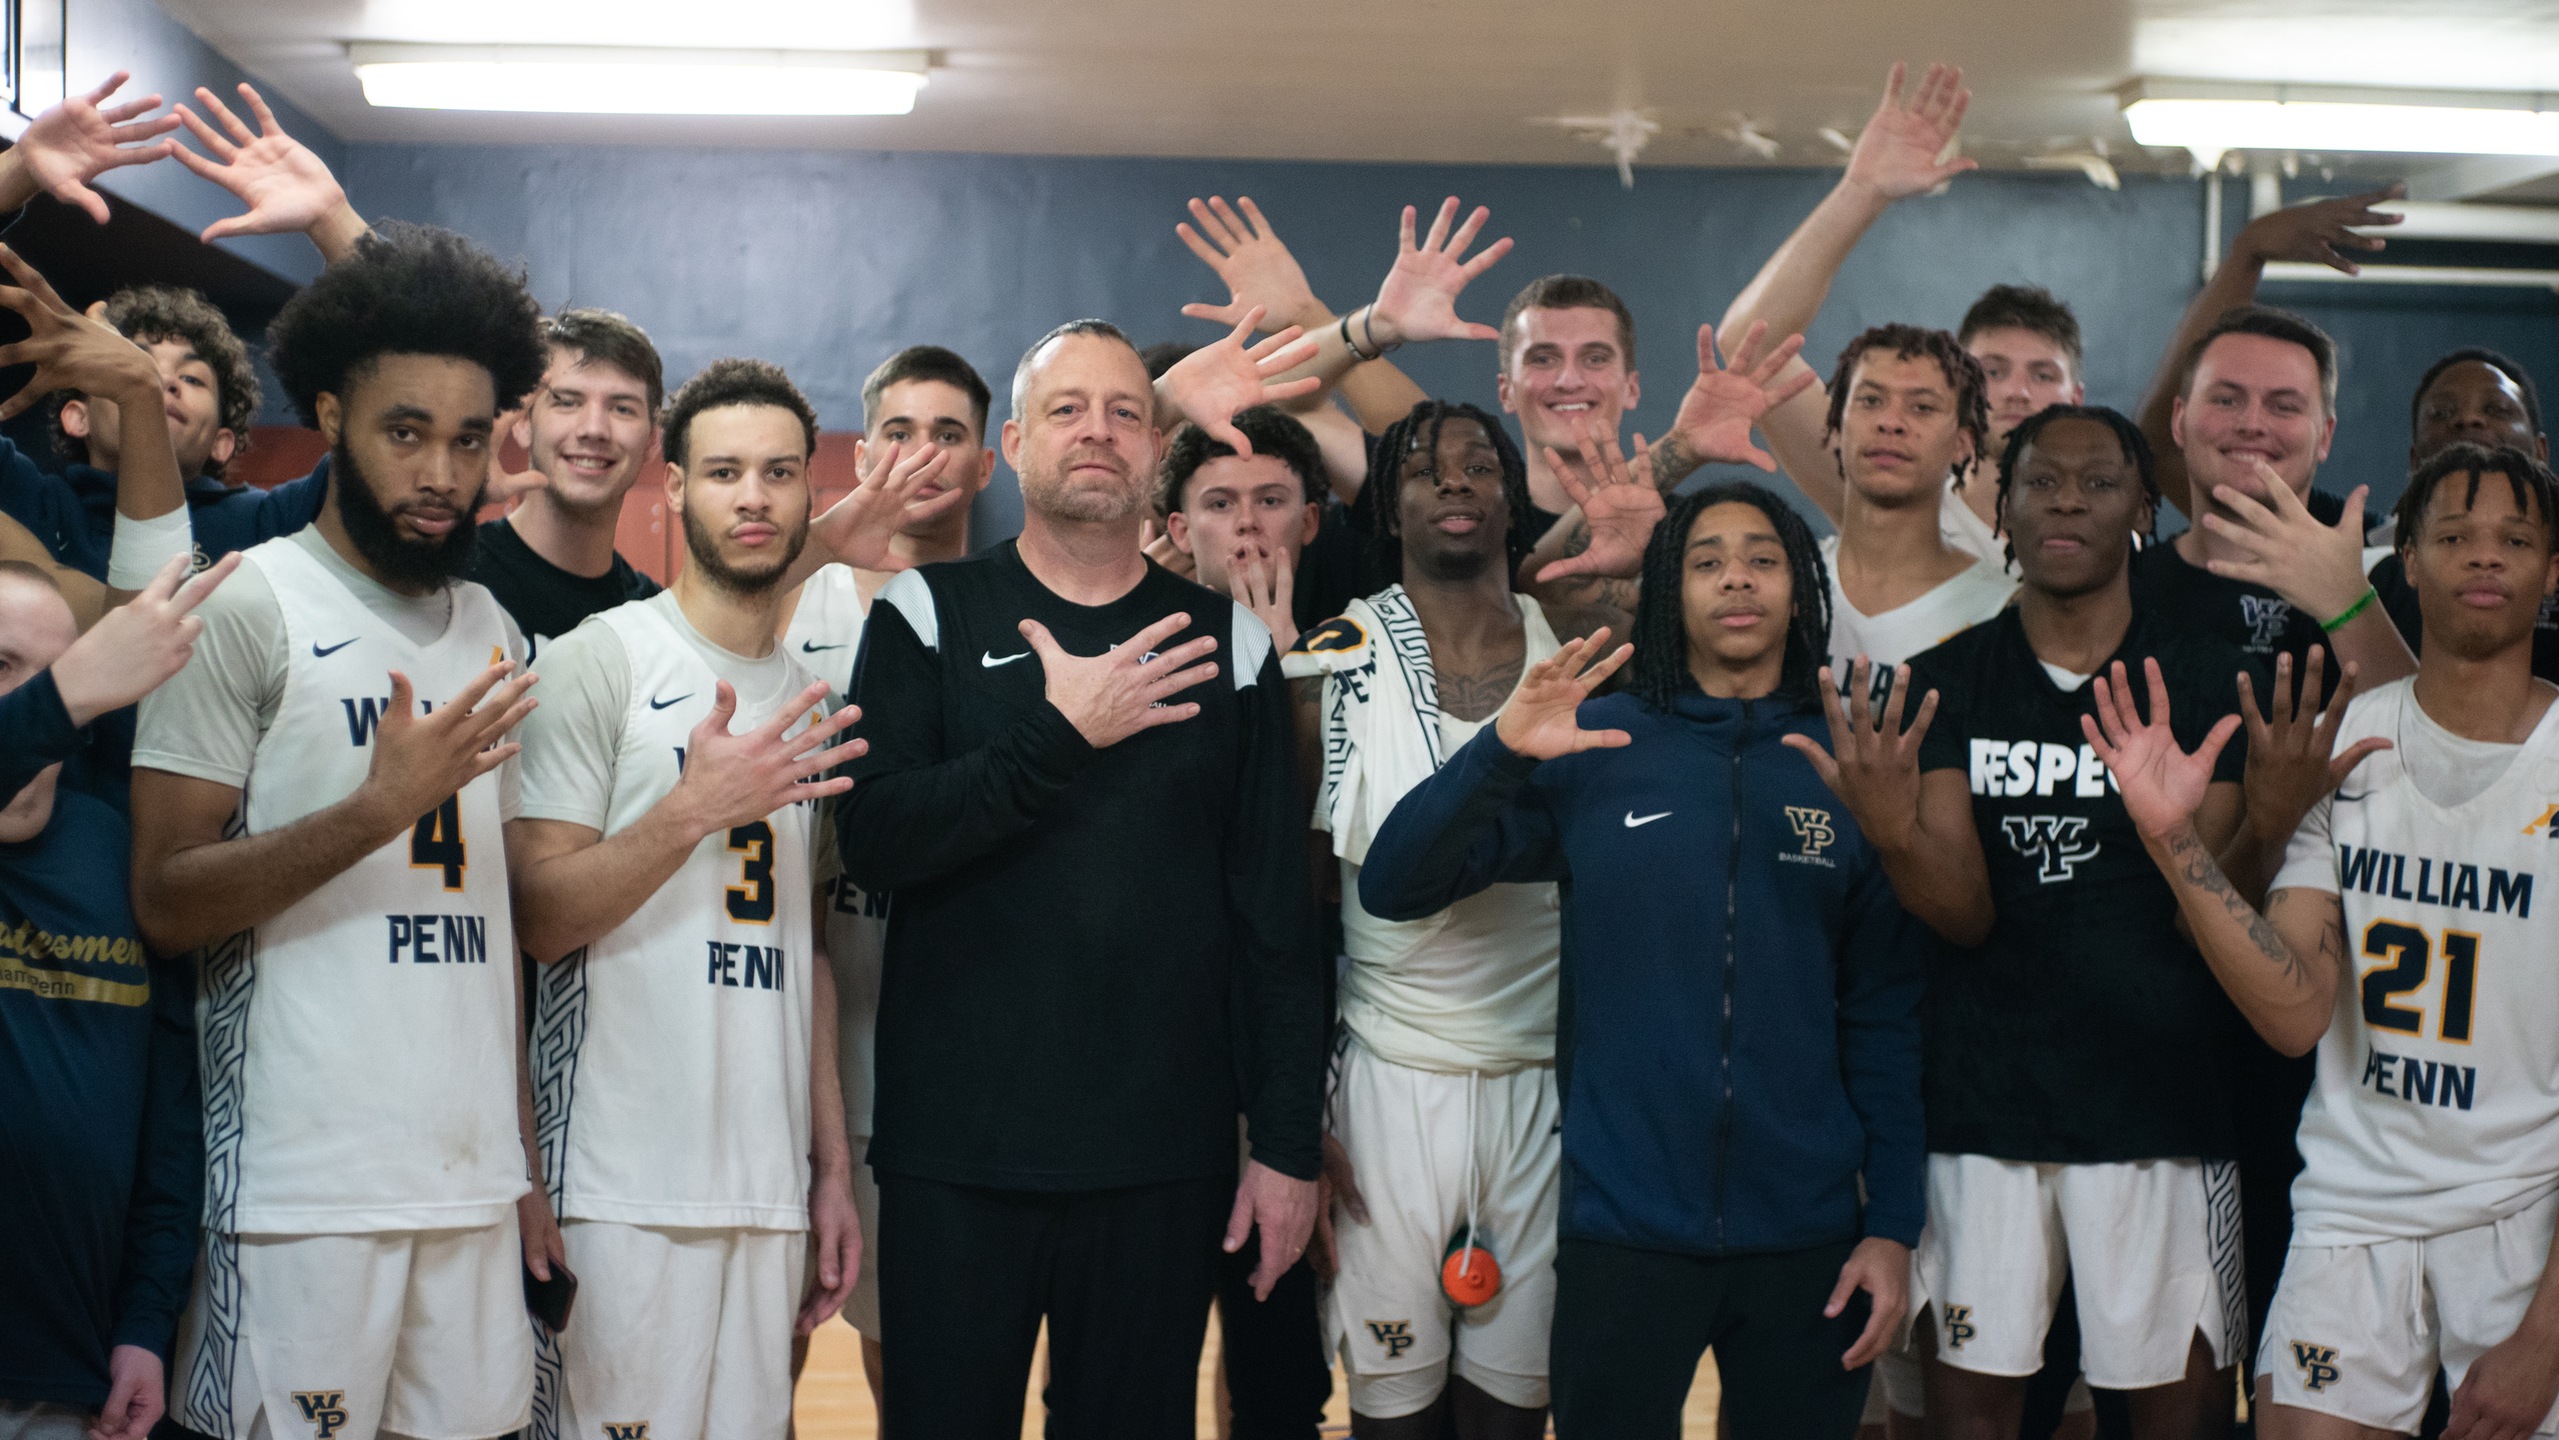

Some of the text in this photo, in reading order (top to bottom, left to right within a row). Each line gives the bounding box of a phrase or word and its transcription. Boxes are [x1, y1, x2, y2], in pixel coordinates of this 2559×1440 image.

[1969, 738, 2121, 798] RESPE
[408, 788, 468, 893] 4
[1784, 805, 1836, 855] WP
[2002, 815, 2102, 884] WP
[725, 817, 776, 926] 3
[1779, 851, 1836, 868] BASKETBALL
[2339, 843, 2534, 920] WILLIAM
[385, 914, 487, 964] PENN
[707, 940, 785, 993] PENN
[2359, 916, 2482, 1047] 21
[2361, 1041, 2477, 1111] PENN
[1364, 1319, 1414, 1361] WP
[2290, 1339, 2342, 1393] WP
[290, 1390, 350, 1440] WP
